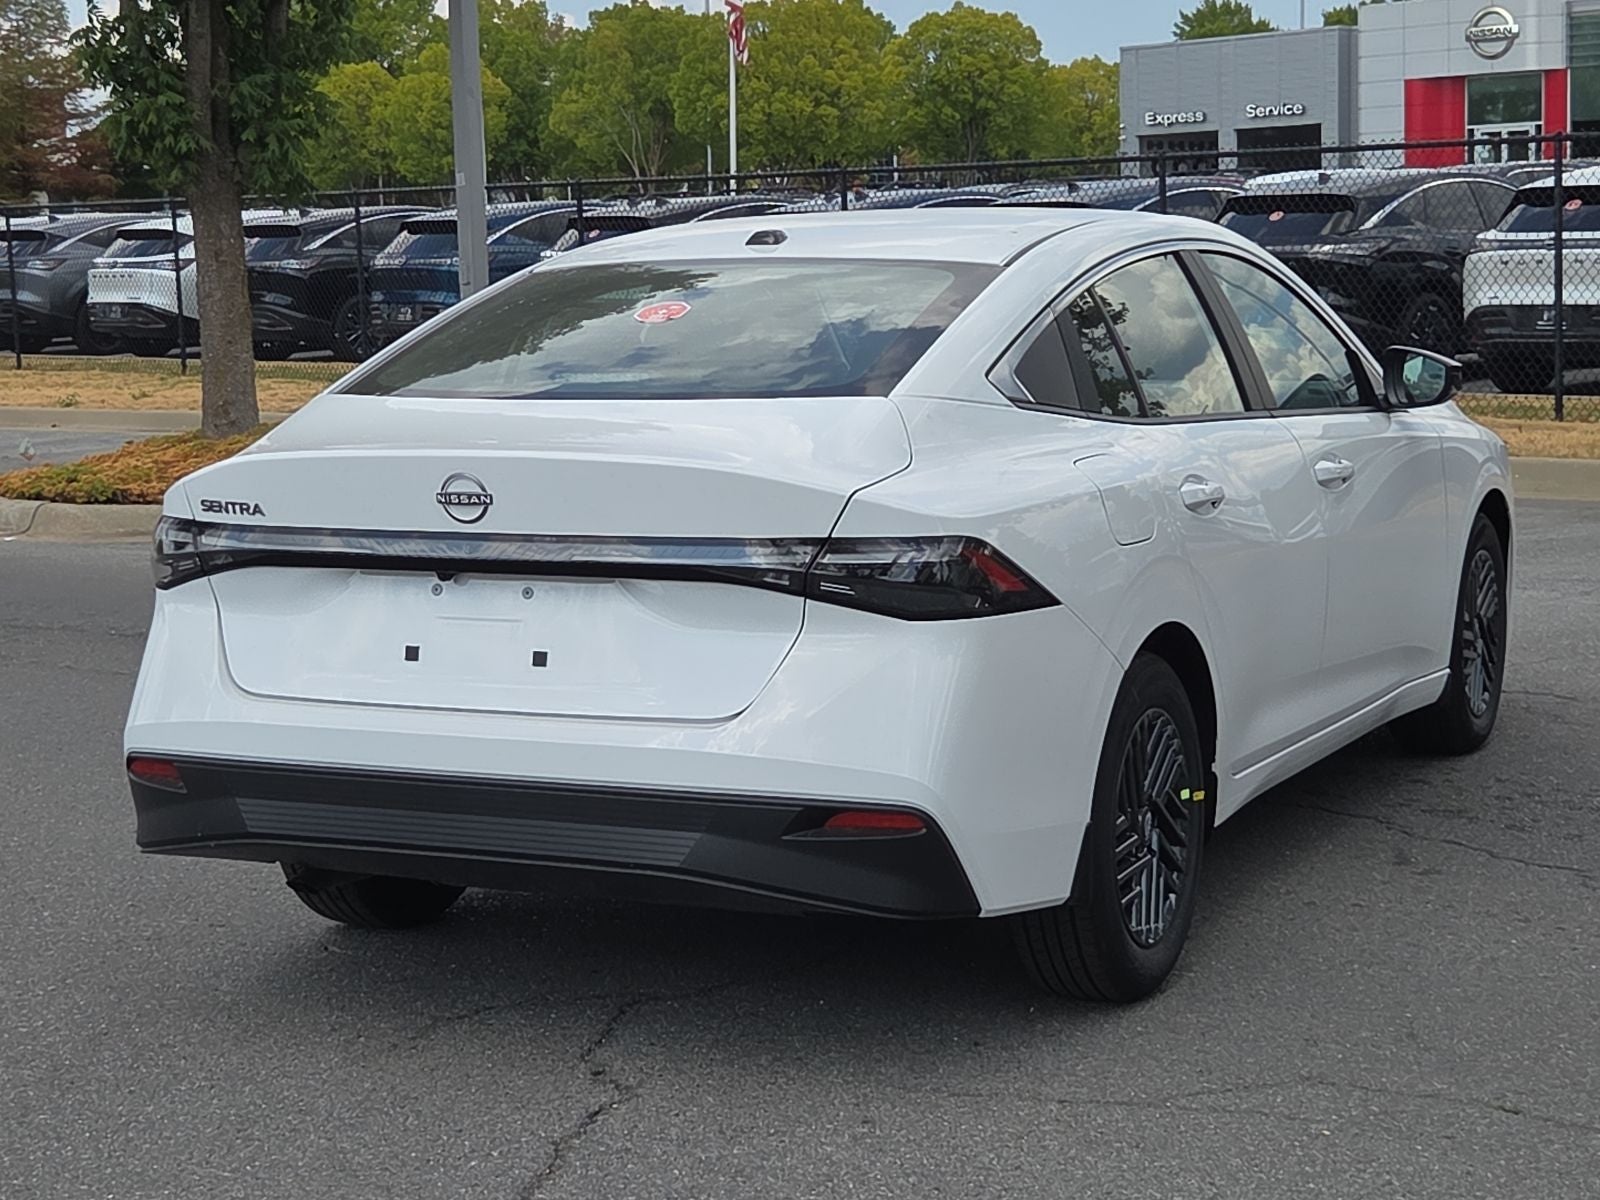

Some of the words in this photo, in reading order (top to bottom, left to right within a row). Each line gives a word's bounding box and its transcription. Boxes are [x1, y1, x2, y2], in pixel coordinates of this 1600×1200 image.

[1468, 26, 1514, 40] NISSAN
[1144, 111, 1205, 127] Express
[1245, 102, 1304, 118] Service
[437, 494, 491, 504] NISSAN
[200, 499, 265, 517] SENTRA
